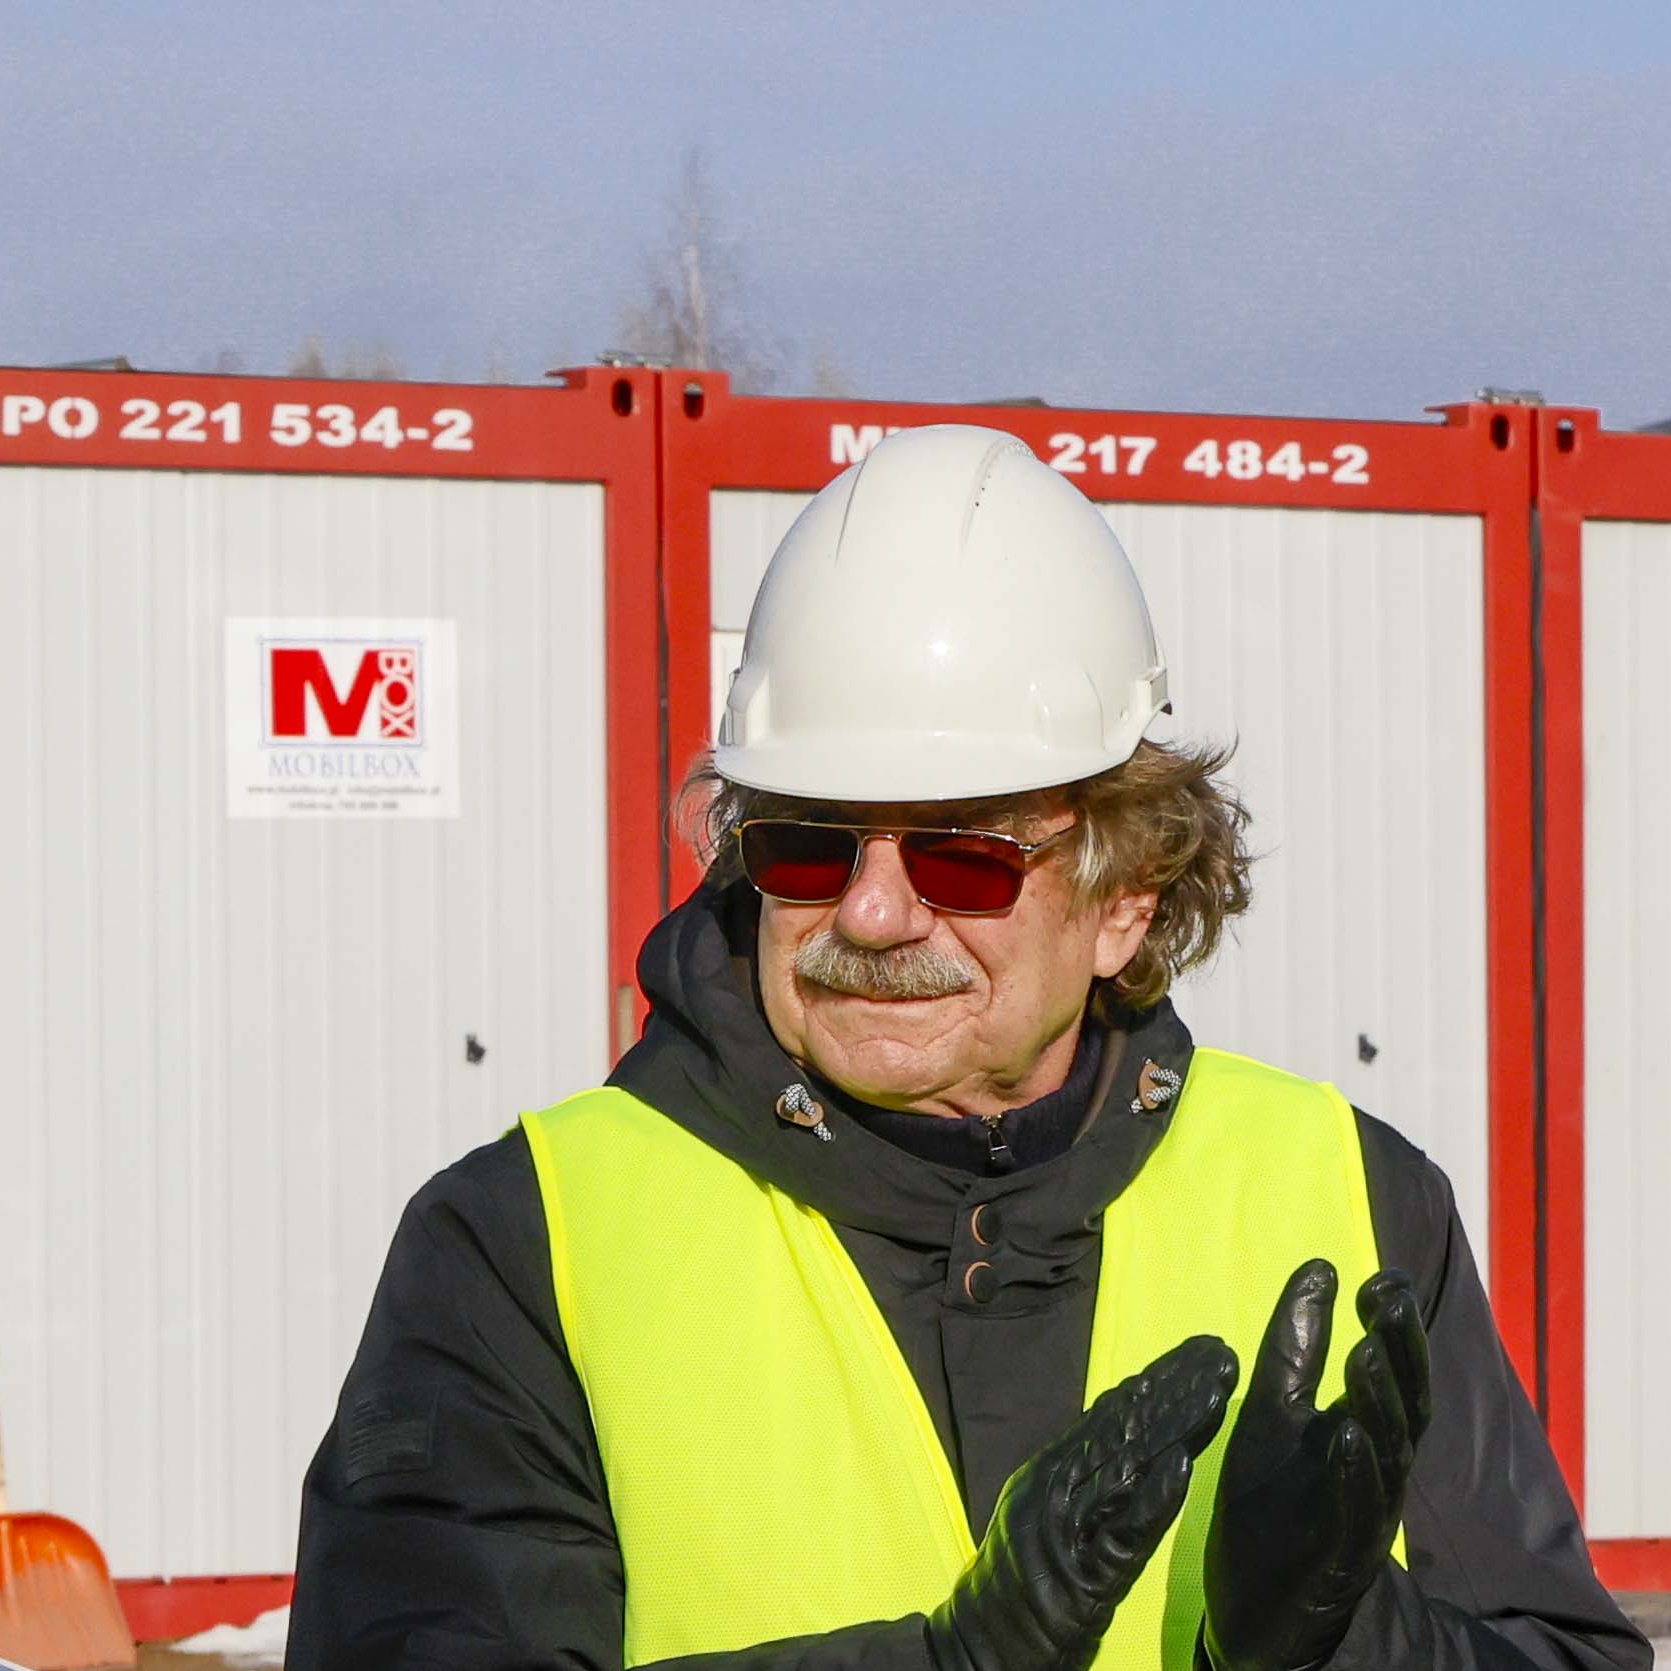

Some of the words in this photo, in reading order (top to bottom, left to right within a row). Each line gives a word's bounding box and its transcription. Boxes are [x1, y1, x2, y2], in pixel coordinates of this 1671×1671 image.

[119, 398, 242, 444] 221
[269, 403, 474, 452] 534-2
[1048, 432, 1157, 476] 217
[1183, 439, 1370, 485] 484-2
[378, 650, 416, 738] BOX
[268, 752, 421, 778] MOBILBOX
